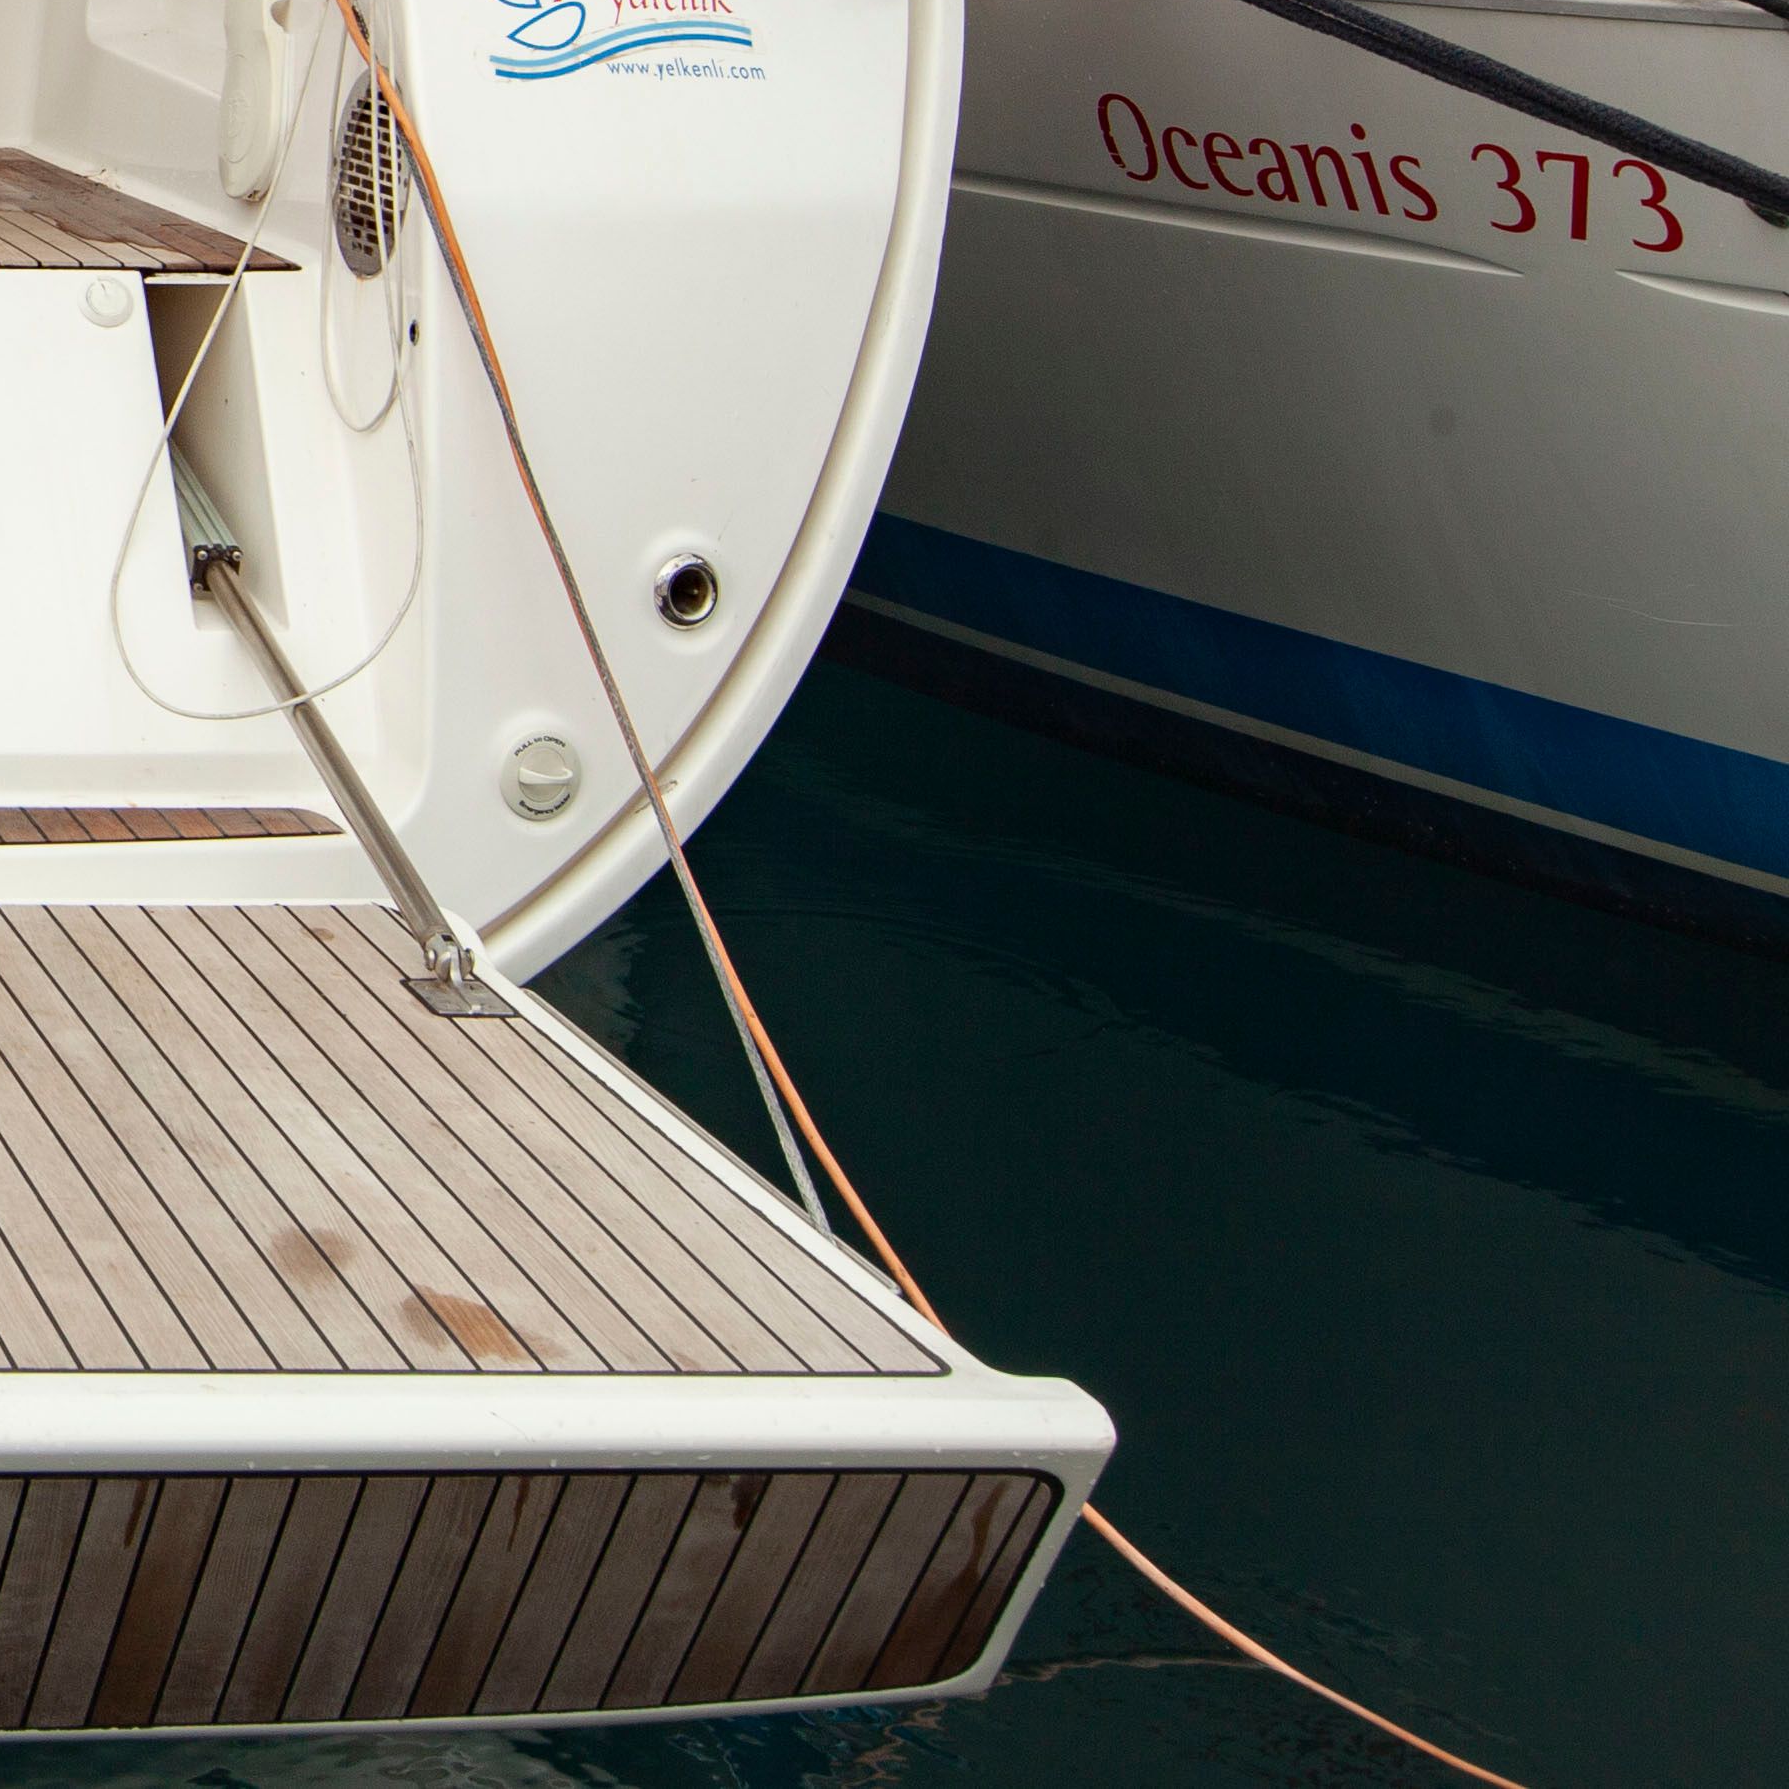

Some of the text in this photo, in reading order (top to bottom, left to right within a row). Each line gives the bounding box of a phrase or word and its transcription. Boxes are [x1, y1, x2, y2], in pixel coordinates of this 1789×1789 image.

[606, 57, 766, 81] www.yelkenli.com
[1096, 93, 1684, 253] Oceanis 373
[514, 740, 533, 757] PULL
[543, 735, 566, 748] OPEN
